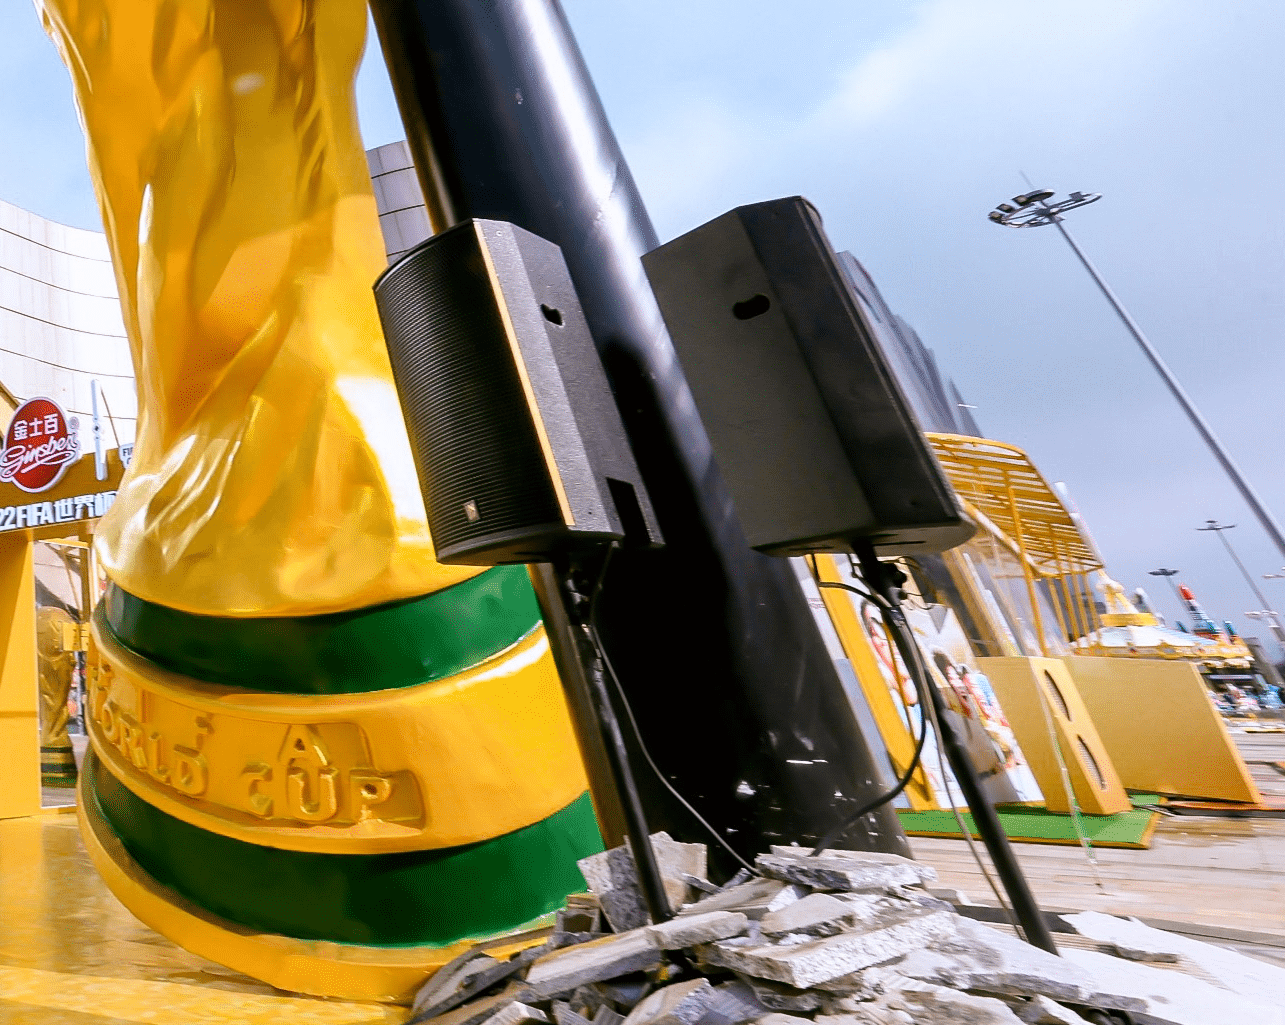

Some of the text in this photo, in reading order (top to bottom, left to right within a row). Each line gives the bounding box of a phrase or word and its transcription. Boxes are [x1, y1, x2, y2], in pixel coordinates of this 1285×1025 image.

[13, 413, 59, 441] 金士百
[241, 761, 392, 825] CUP
